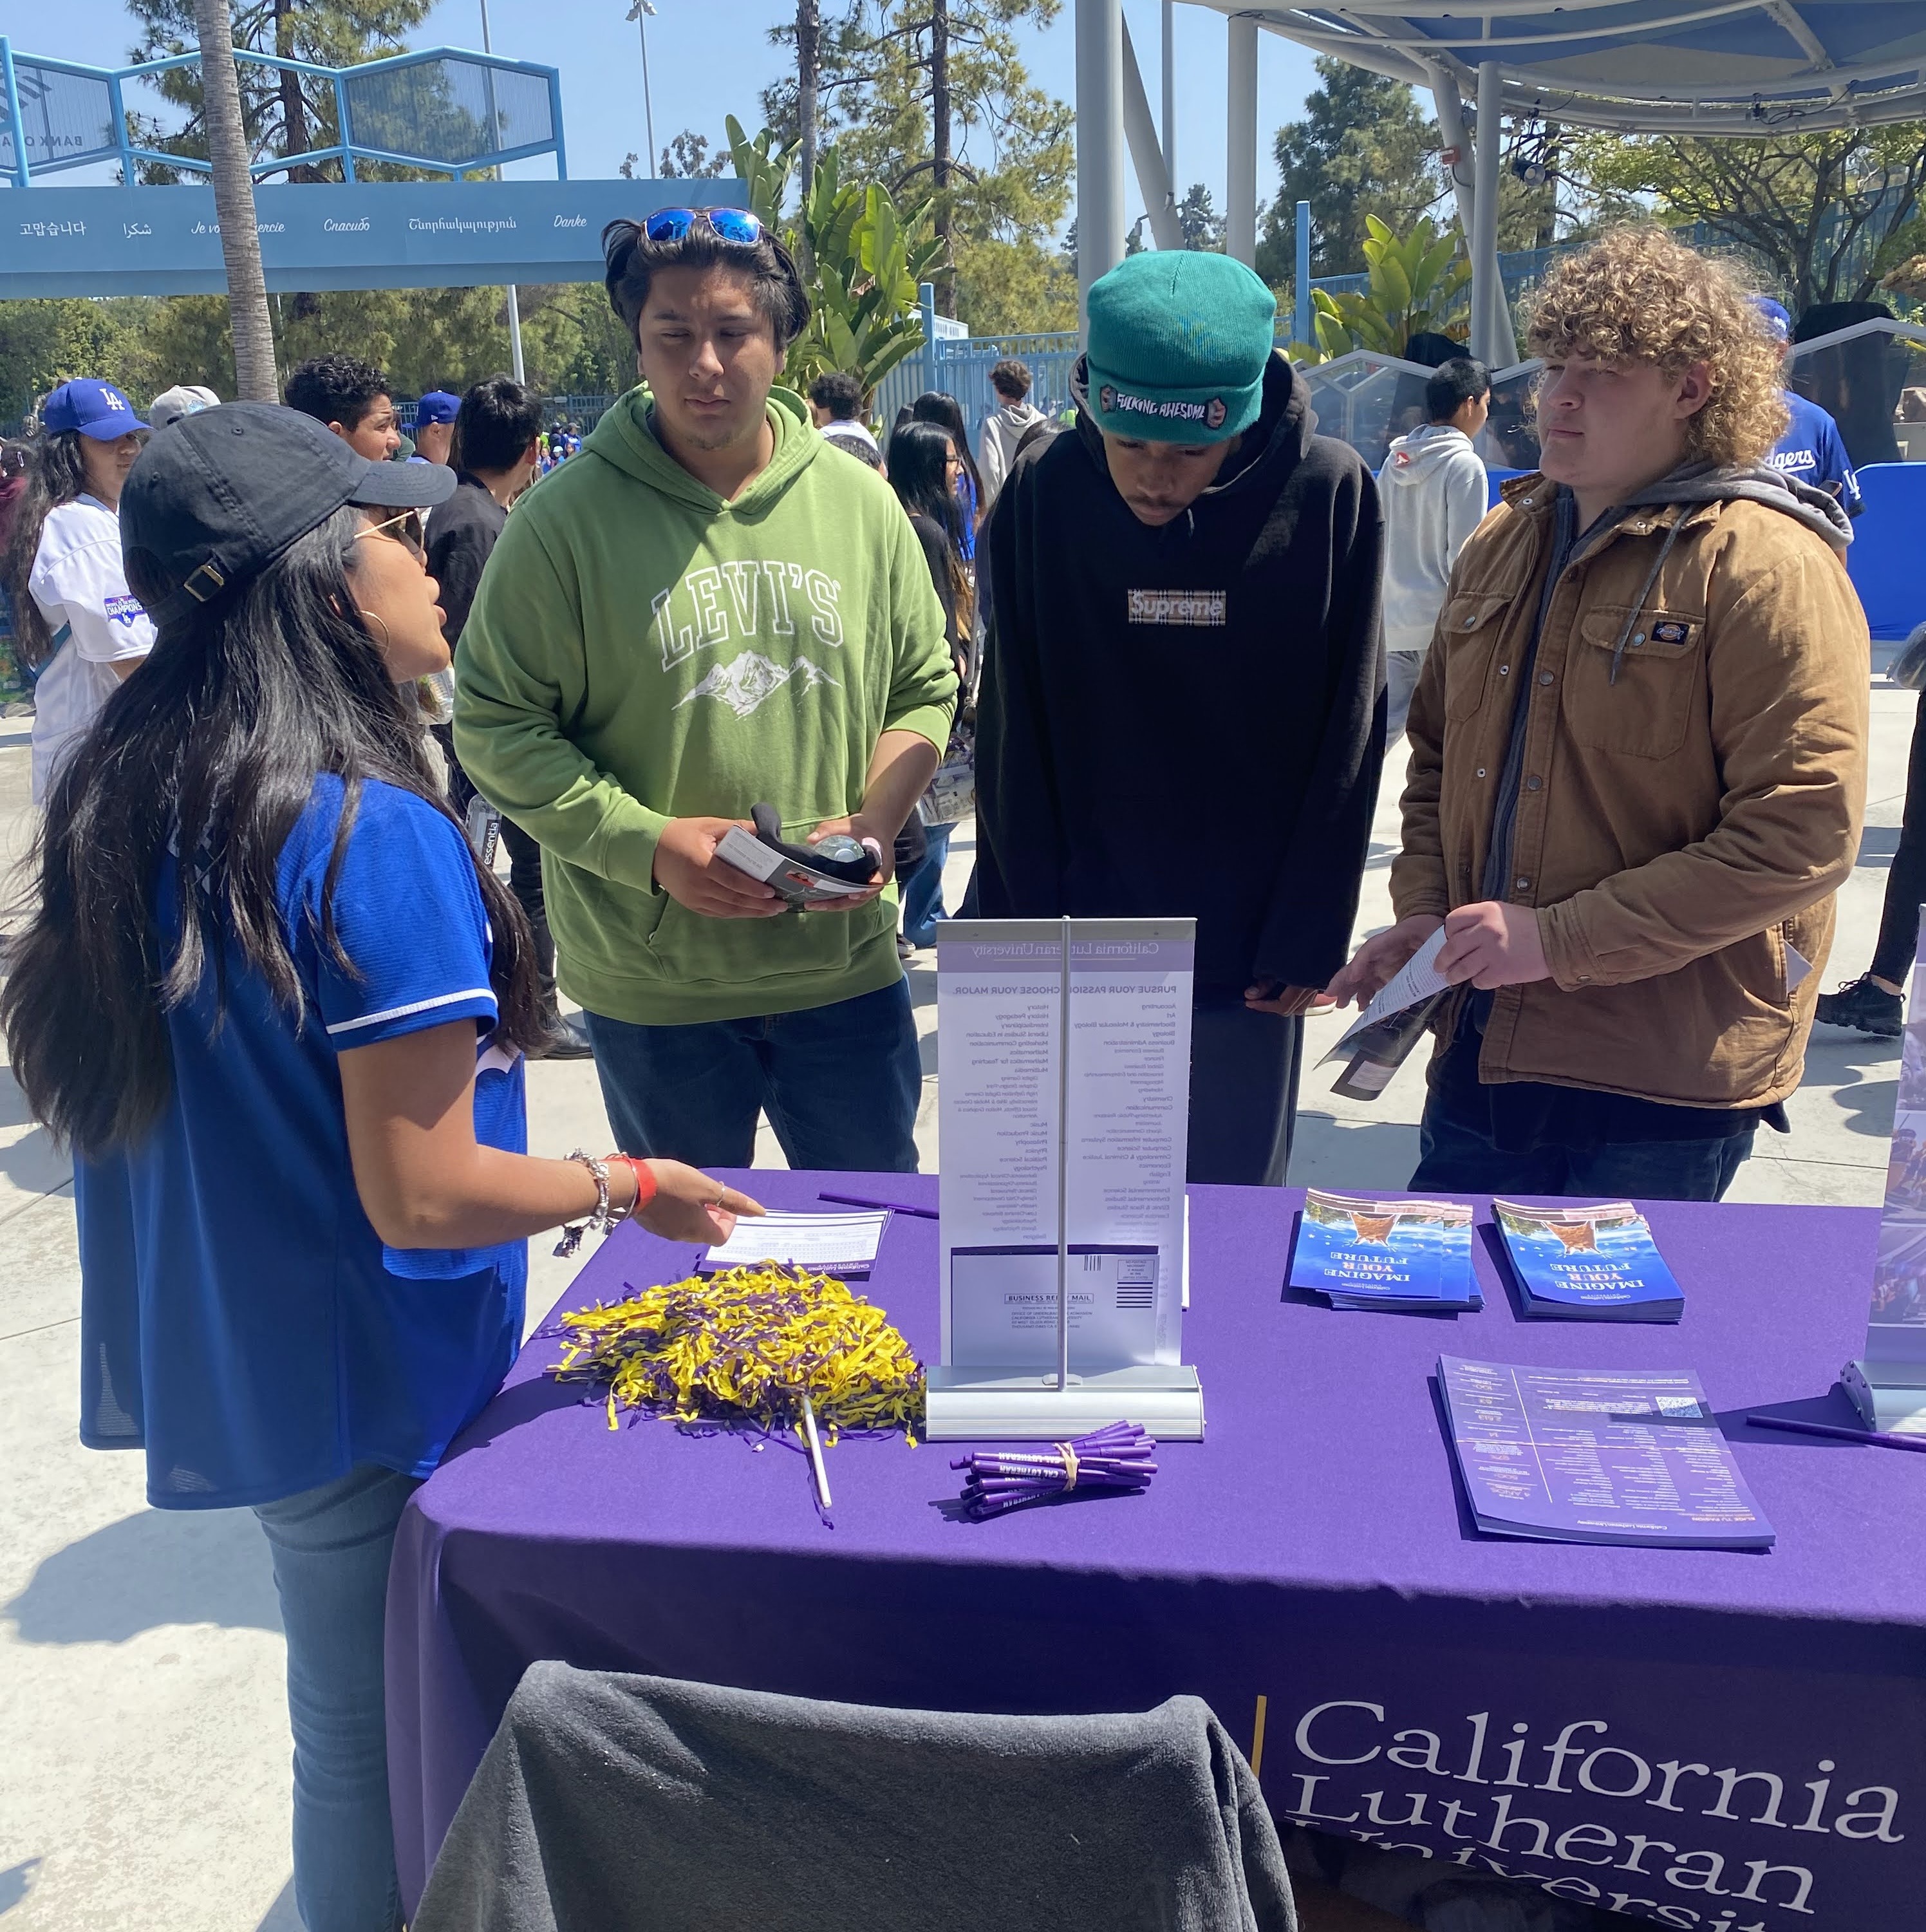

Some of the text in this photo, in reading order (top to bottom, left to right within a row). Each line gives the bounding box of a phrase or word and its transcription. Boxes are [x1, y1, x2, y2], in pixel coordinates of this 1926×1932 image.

[191, 221, 206, 234] Je
[324, 217, 369, 232] Спасибо
[554, 214, 587, 228] Danke
[20, 221, 86, 237] 고맙습니다
[123, 222, 152, 238] شكرا
[99, 388, 125, 410] LA
[1117, 393, 1205, 420] FUCKING AWESOME
[1765, 447, 1815, 473] dgers
[1132, 591, 1223, 623] Supreme
[650, 560, 844, 673] LEVI'S
[484, 822, 499, 865] essentia
[1331, 1252, 1408, 1264] FUTURE
[1342, 1262, 1394, 1272] YOUR
[1549, 1262, 1632, 1272] FUTURE
[1323, 1268, 1411, 1282] IMAGINE
[1567, 1273, 1623, 1281] YOUR
[1555, 1280, 1645, 1291] IMAGINE
[1000, 1465, 1059, 1477] CAL LUTHERAN
[1295, 1700, 1905, 1843] California
[1286, 1773, 1815, 1915] Lutheran
